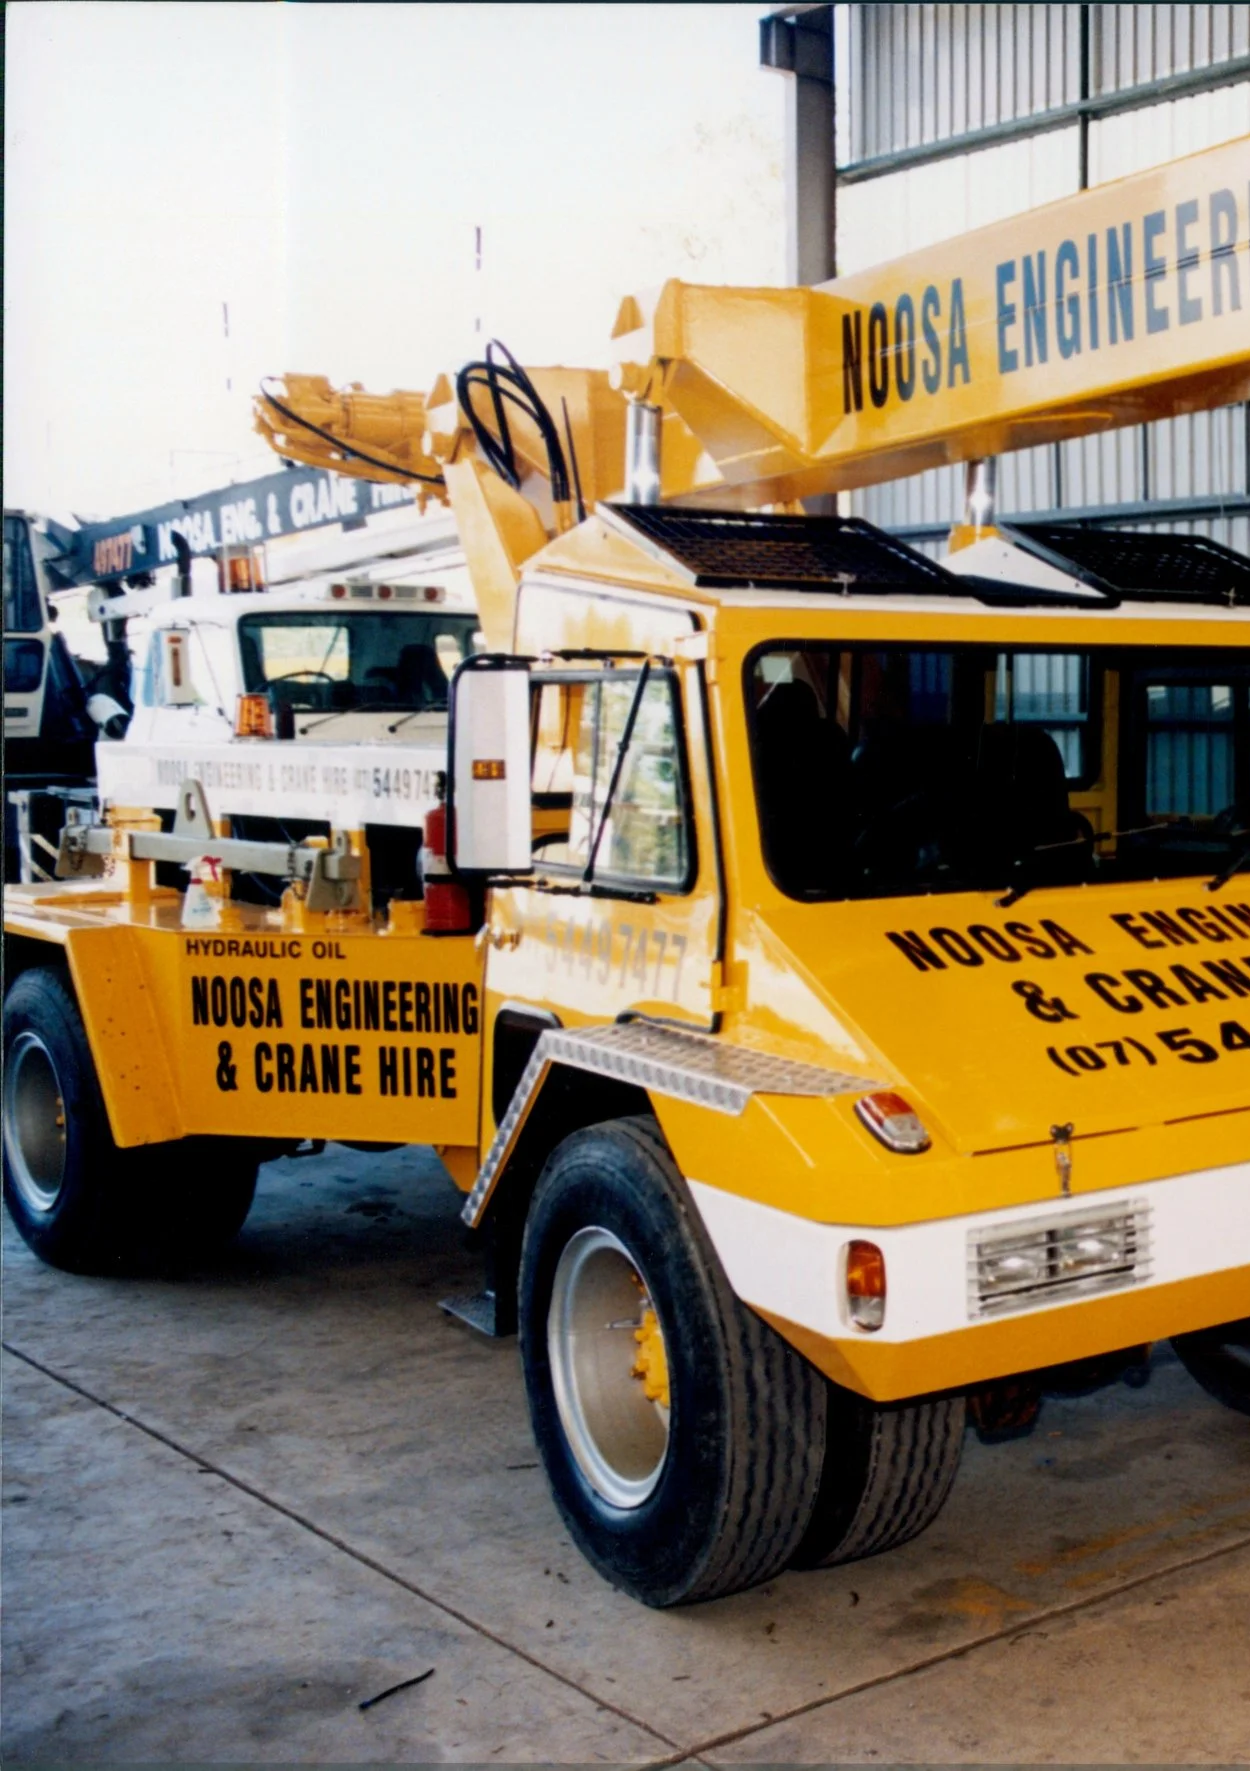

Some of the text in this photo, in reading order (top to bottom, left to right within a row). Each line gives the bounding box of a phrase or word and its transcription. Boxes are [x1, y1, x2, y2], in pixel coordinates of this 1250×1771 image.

[842, 277, 971, 415] NOOSA
[290, 468, 358, 529] CRANE
[186, 939, 346, 960] HYDRAULIC OIL
[545, 910, 687, 1002] 54497477
[885, 918, 1095, 972] NOOSA
[192, 975, 479, 1035] NOOSA ENGINEERING
[1011, 979, 1081, 1024] &
[216, 1040, 457, 1099] & CRANE HIRE
[1046, 1035, 1158, 1077] (07)
